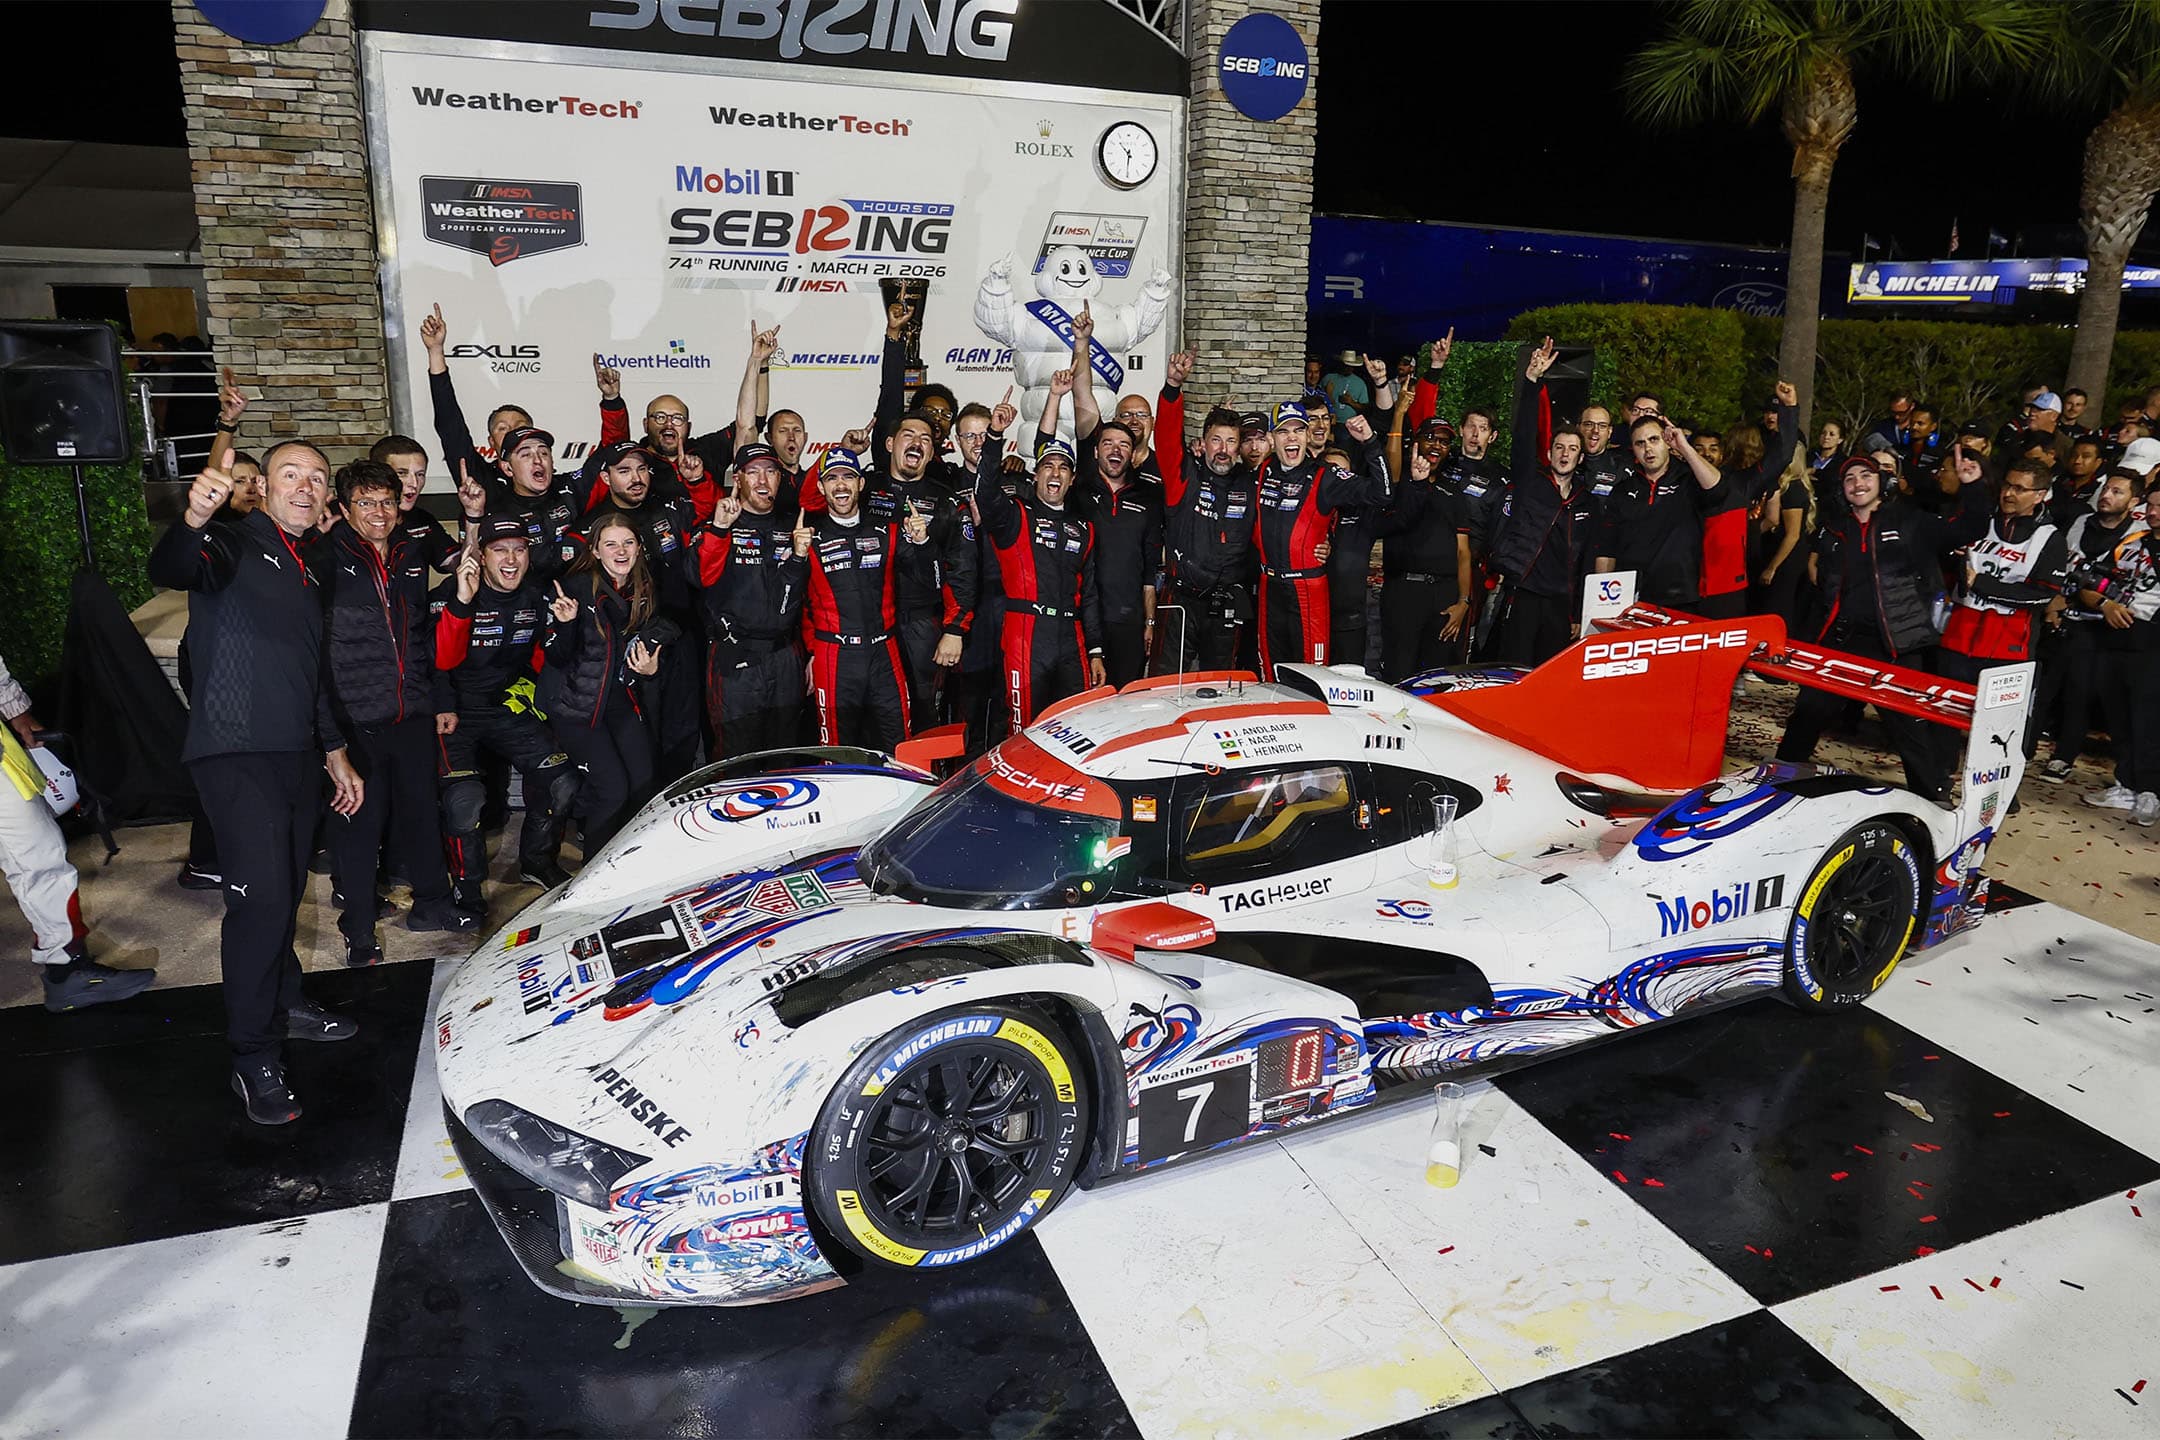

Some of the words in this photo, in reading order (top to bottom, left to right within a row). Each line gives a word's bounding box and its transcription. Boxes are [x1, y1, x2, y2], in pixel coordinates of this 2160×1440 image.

[1014, 141, 1075, 158] ROLEX
[675, 165, 761, 195] Mobil
[490, 186, 533, 199] IMSA
[430, 202, 575, 221] WeatherTech
[862, 202, 923, 215] HOURS
[927, 204, 951, 215] OF
[1064, 227, 1091, 236] IMSA
[1097, 237, 1135, 245] MICHELIN
[668, 257, 703, 270] 74th
[708, 259, 788, 272] RUNNING
[810, 262, 868, 275] MARCH
[899, 265, 947, 278] 2026
[798, 280, 849, 293] IMSA
[1884, 275, 2000, 292] MICHELIN
[1038, 304, 1122, 383] MICELIN
[490, 361, 541, 373] RACING
[790, 353, 880, 365] MICHELIN
[945, 348, 992, 364] ALAN
[993, 348, 1013, 365] JA
[955, 365, 994, 373] Automotive
[996, 365, 1014, 373] Netw
[736, 546, 761, 556] Ansys
[1583, 629, 1748, 663] PORSCHE
[1583, 659, 1649, 681] 963
[1992, 675, 2023, 686] HYBRID
[1329, 687, 1362, 701] Mobil
[1999, 691, 2020, 702] BOSCH
[1039, 718, 1083, 748] Mobil
[1242, 723, 1297, 735] ANDLAUER
[1247, 734, 1277, 746] NASR
[1254, 743, 1303, 757] HEINRICH
[987, 744, 1086, 802] ORSCHE
[1972, 767, 2000, 785] Mobil
[789, 877, 825, 907] TAG
[1903, 853, 1921, 911] MICHELIN
[752, 880, 794, 914] HEUER
[1655, 882, 1750, 938] Mobil
[612, 918, 680, 951] 7
[675, 900, 703, 948] WeatherTech
[1793, 924, 1813, 988] MICHELIN
[517, 953, 549, 998] Mobil
[893, 1019, 992, 1069] MICHELIN
[1008, 1027, 1033, 1041] PILOT
[1033, 1039, 1056, 1062] SPORT
[1146, 1054, 1245, 1085] WeatherTech
[1290, 1032, 1322, 1088] 0
[1058, 1083, 1072, 1098] M
[593, 1067, 692, 1148] PENSKE
[1177, 1080, 1215, 1143] 7
[699, 1187, 759, 1207] Mobil
[841, 1196, 858, 1210] M
[582, 1224, 618, 1246] TAG
[708, 1215, 791, 1242] MOTUL
[584, 1238, 620, 1262] HEUER
[862, 1230, 890, 1253] SPORT
[929, 1215, 1023, 1266] MICHELIN
[893, 1249, 914, 1262] PILOT
